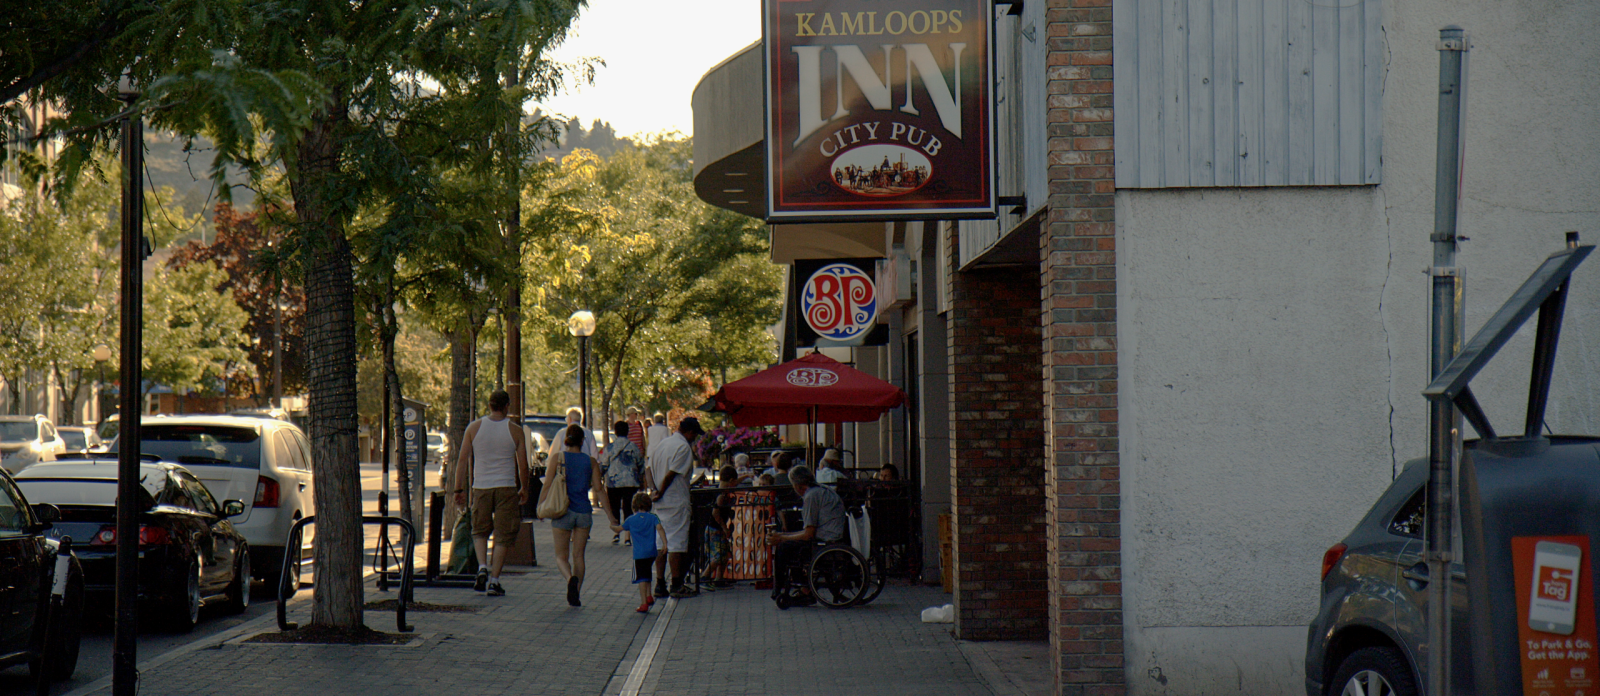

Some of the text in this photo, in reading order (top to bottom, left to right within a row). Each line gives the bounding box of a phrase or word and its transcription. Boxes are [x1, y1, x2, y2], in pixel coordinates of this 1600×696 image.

[795, 9, 963, 37] KAMLOOPS
[791, 42, 967, 149] INN
[819, 121, 943, 158] CITY PUB
[807, 273, 874, 332] BP
[1542, 581, 1567, 600] Tag
[1527, 639, 1593, 650] To Park & Go,
[1528, 650, 1590, 661] Get the App.
